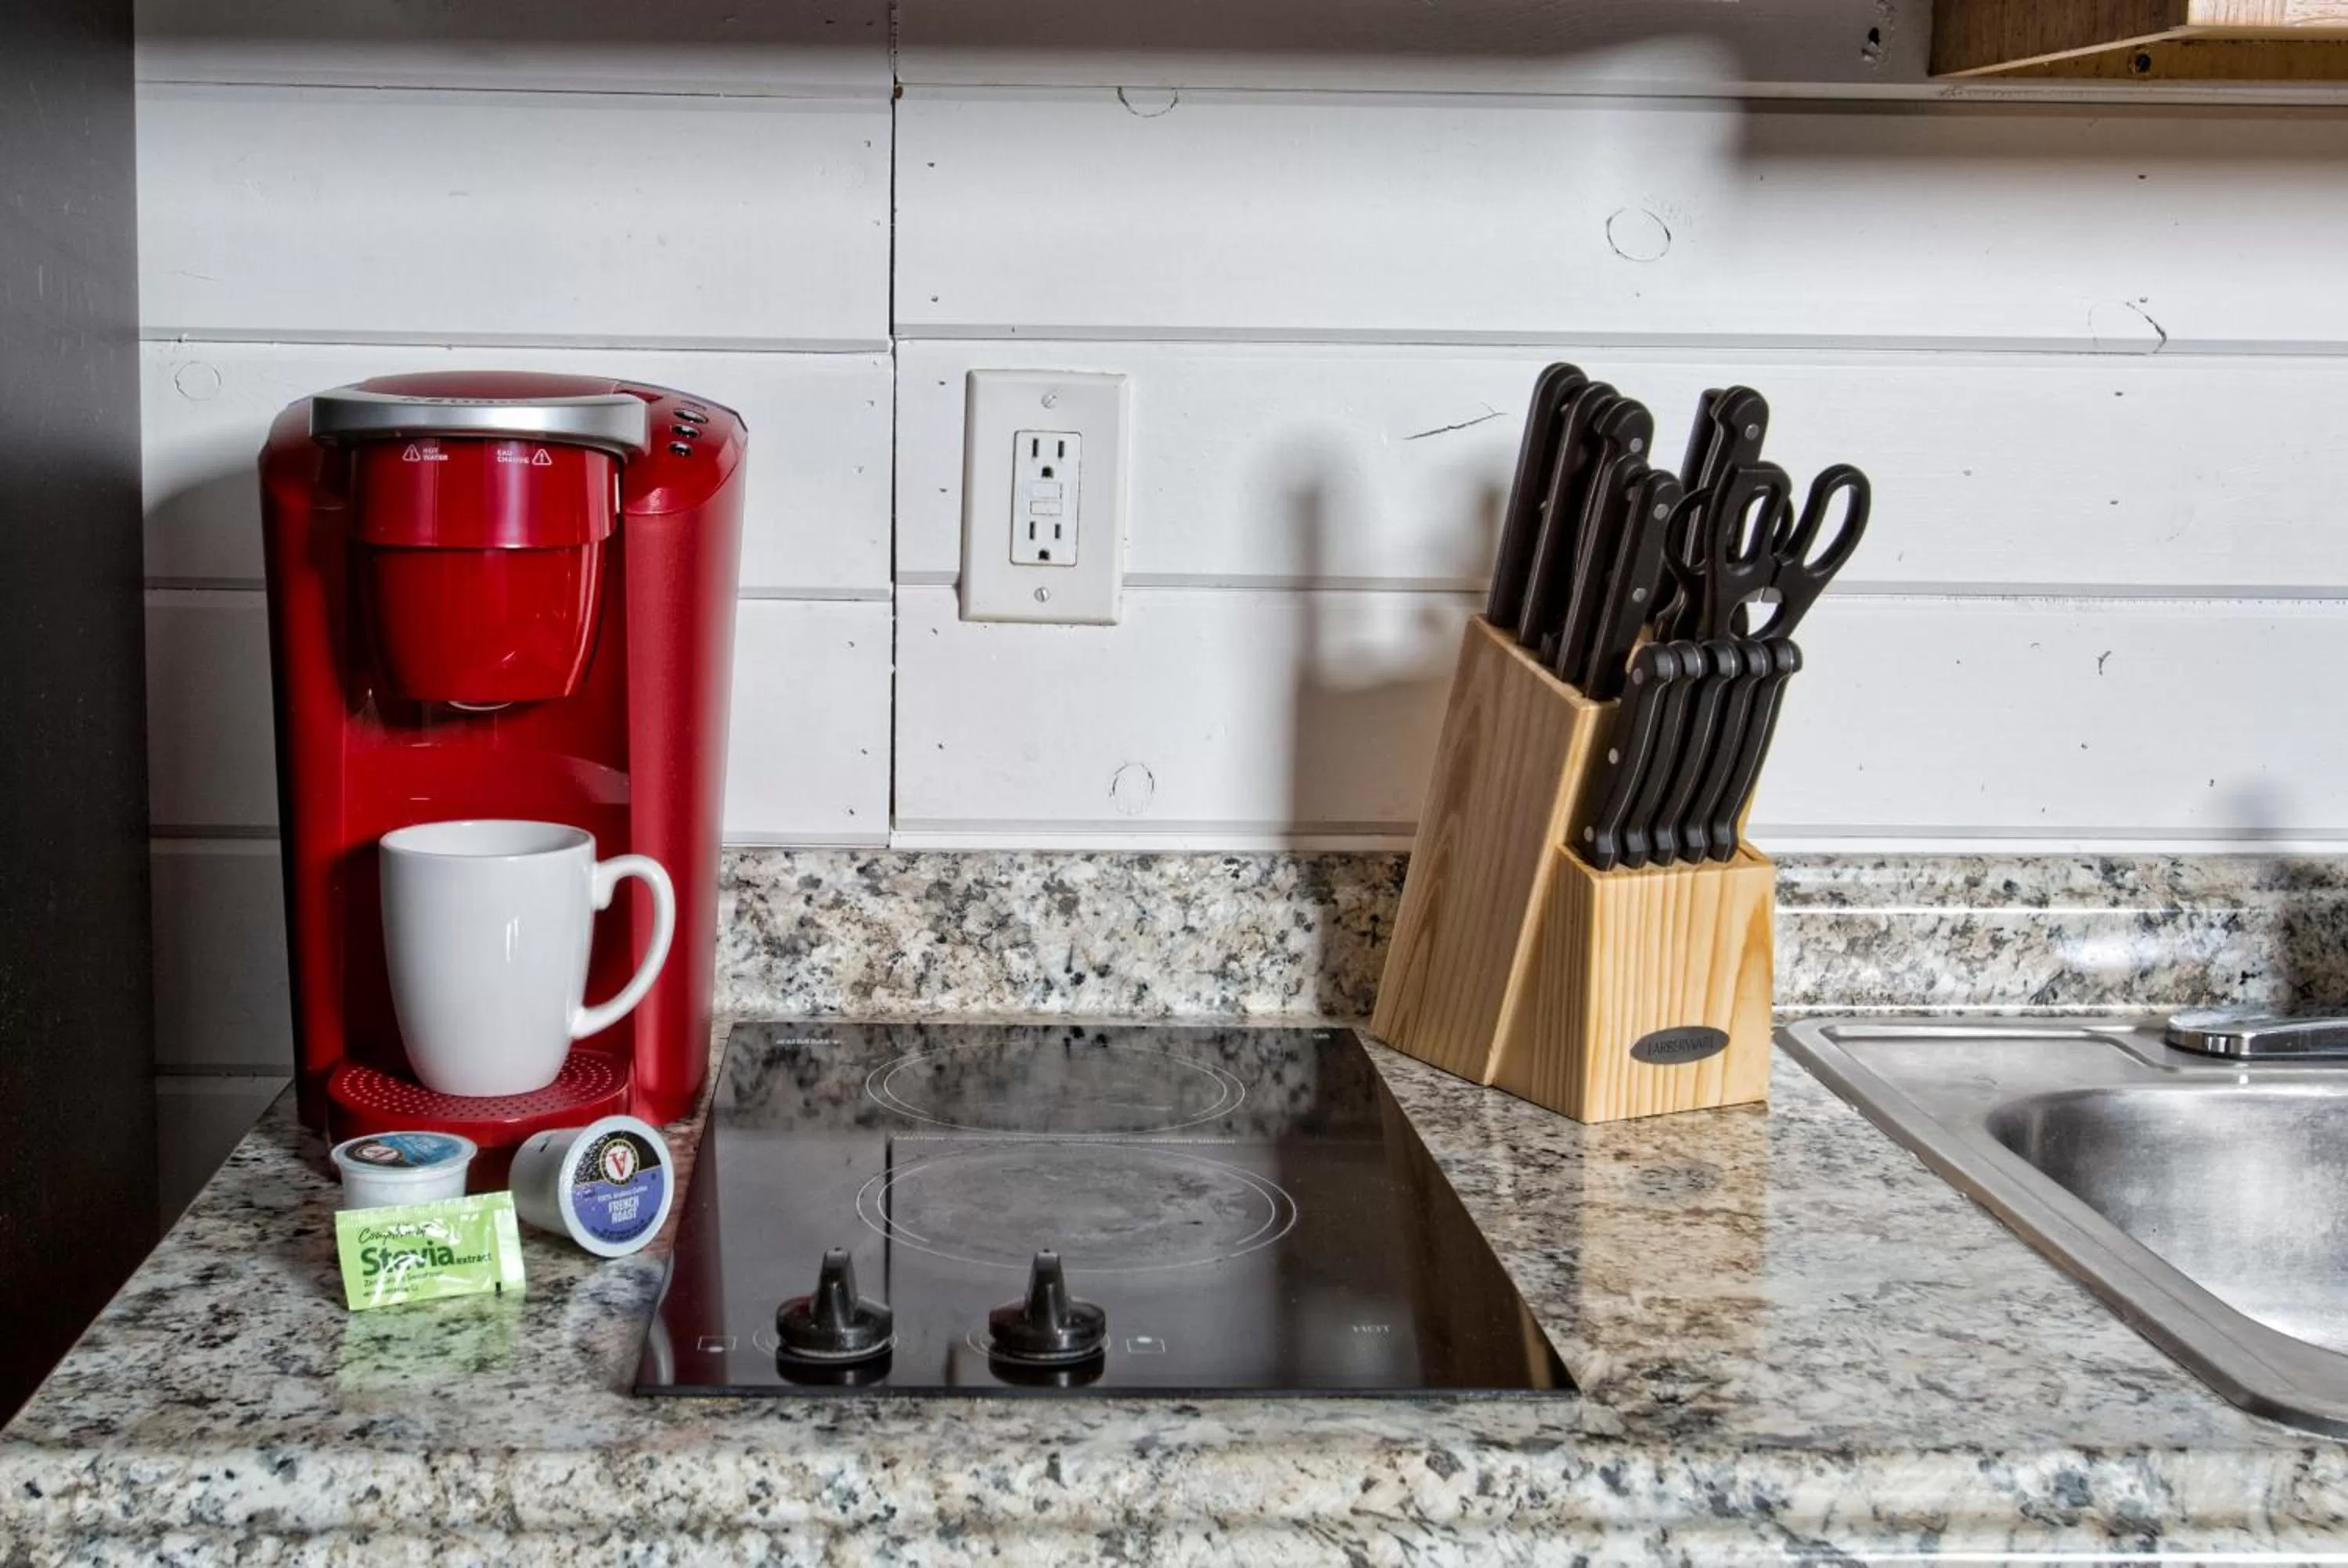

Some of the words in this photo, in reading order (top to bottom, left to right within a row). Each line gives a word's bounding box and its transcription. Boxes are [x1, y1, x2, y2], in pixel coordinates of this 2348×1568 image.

[608, 1195, 639, 1214] FRENCH
[611, 1206, 637, 1225] ROAST
[360, 1240, 455, 1276] Stevia
[456, 1252, 493, 1265] extract
